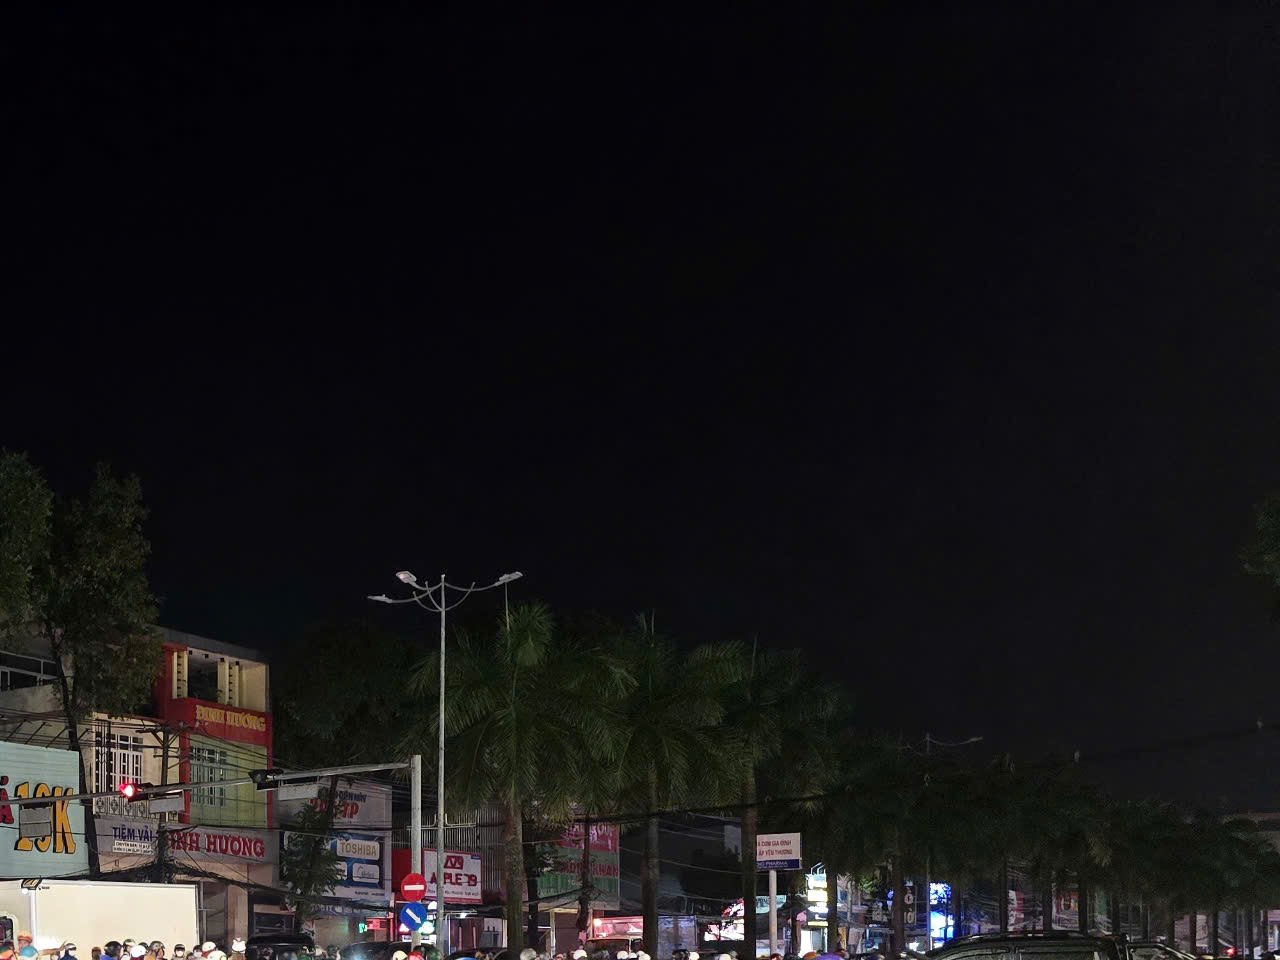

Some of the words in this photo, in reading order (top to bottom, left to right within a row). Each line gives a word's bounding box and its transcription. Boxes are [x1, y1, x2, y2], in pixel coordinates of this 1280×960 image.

[112, 824, 135, 841] TIỆM
[138, 825, 153, 842] VẢI
[165, 833, 200, 852] INH
[205, 832, 265, 858] HƯƠNG
[340, 842, 377, 856] TOSHIBA
[430, 872, 462, 886] APLE
